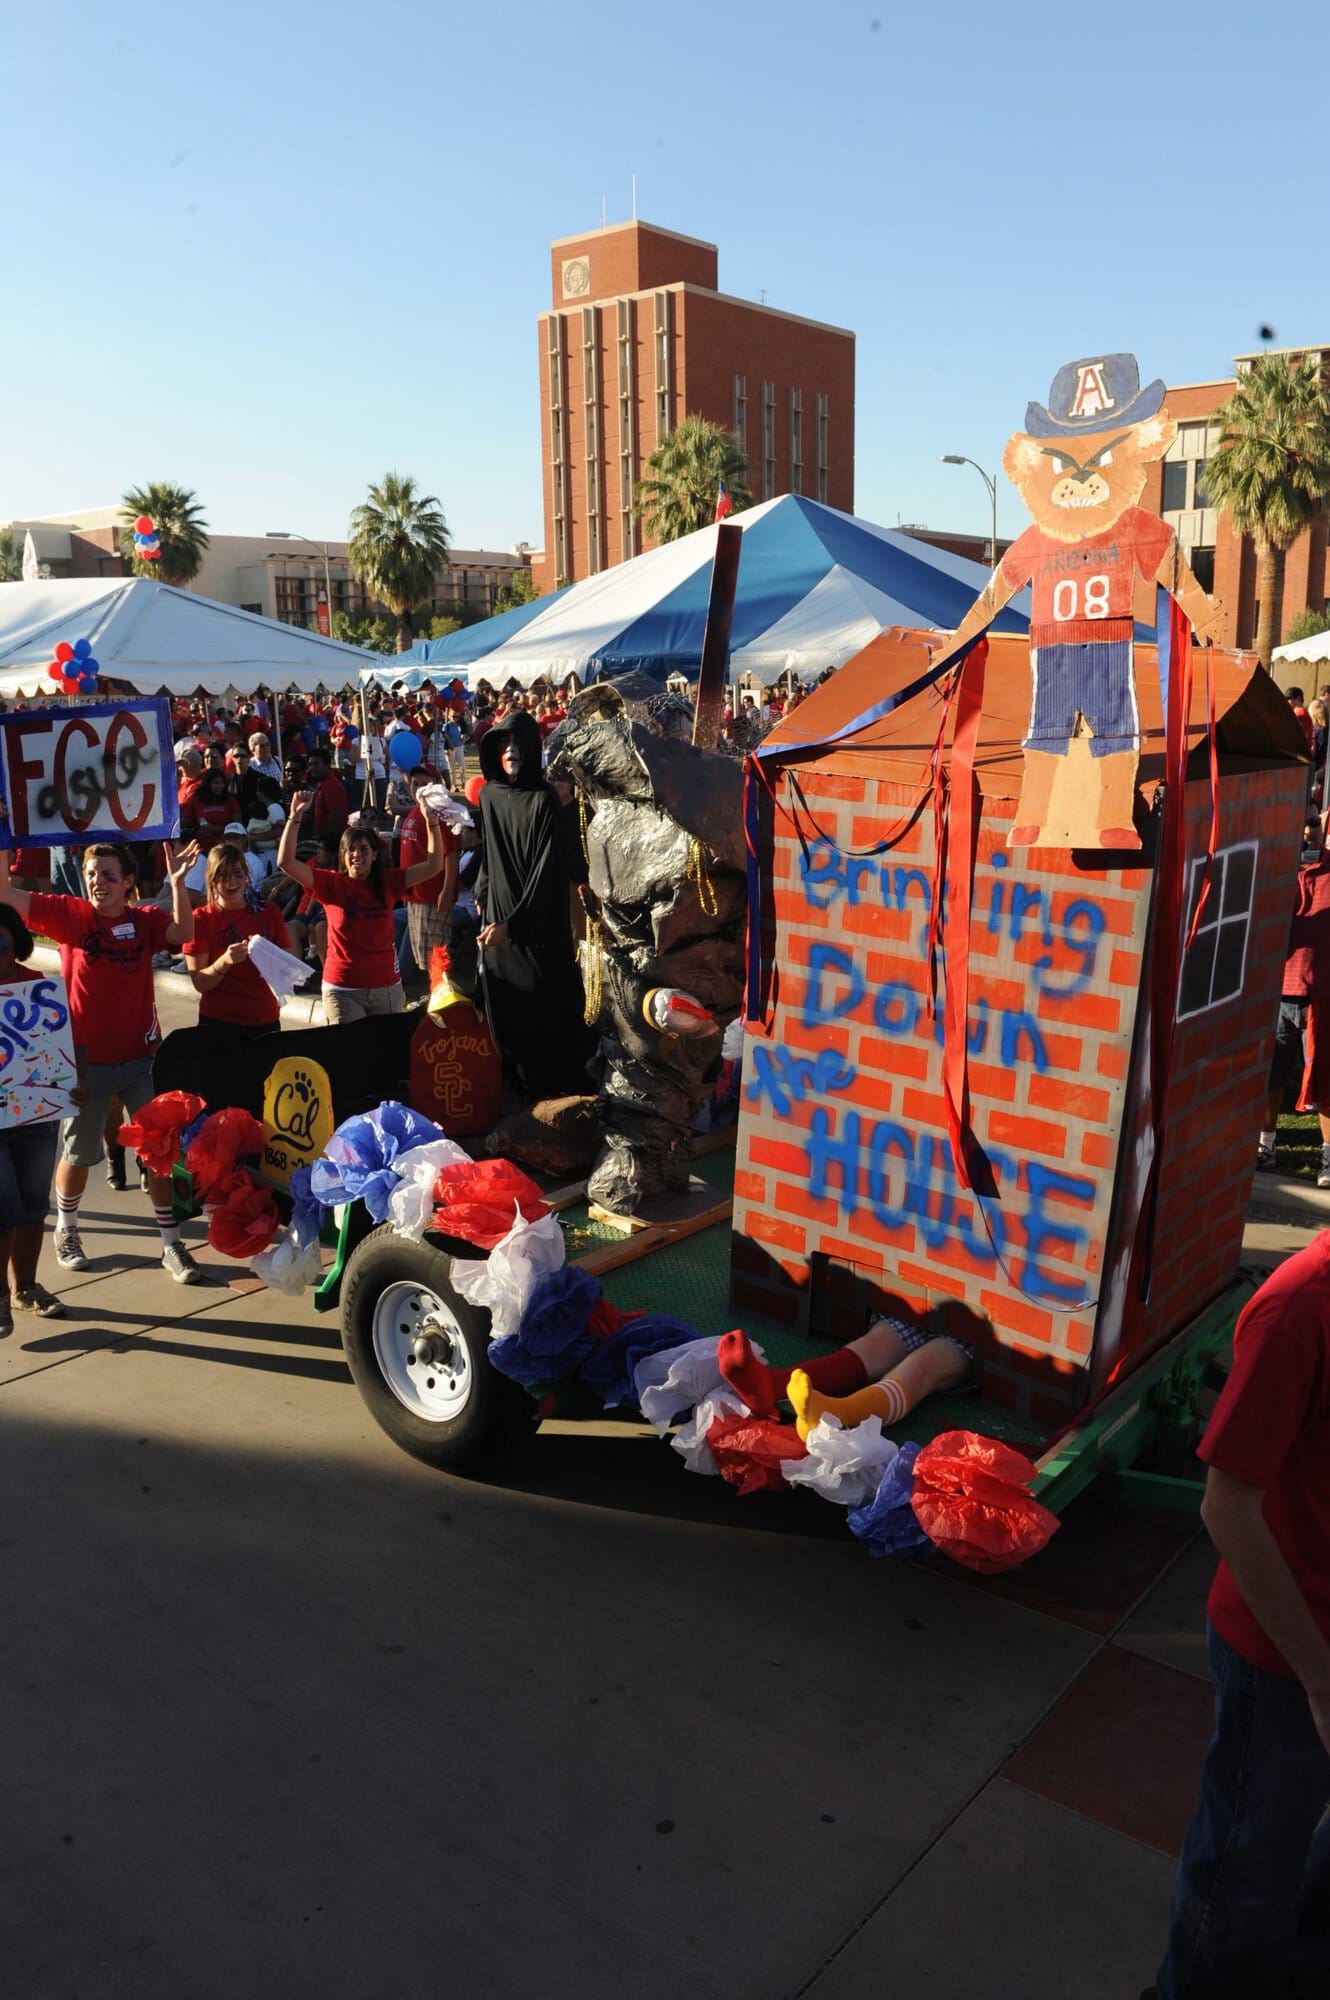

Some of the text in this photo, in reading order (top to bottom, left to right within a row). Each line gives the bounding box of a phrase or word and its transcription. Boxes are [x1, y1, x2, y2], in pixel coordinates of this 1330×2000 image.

[1069, 363, 1115, 418] A
[1041, 542, 1119, 579] ARIZONA
[1053, 575, 1110, 621] 08
[4, 710, 156, 837] FCC
[802, 942, 1048, 1074] Down
[272, 1083, 320, 1151] Cal
[433, 1061, 474, 1119] SC
[805, 1107, 1096, 1301] HOUSE
